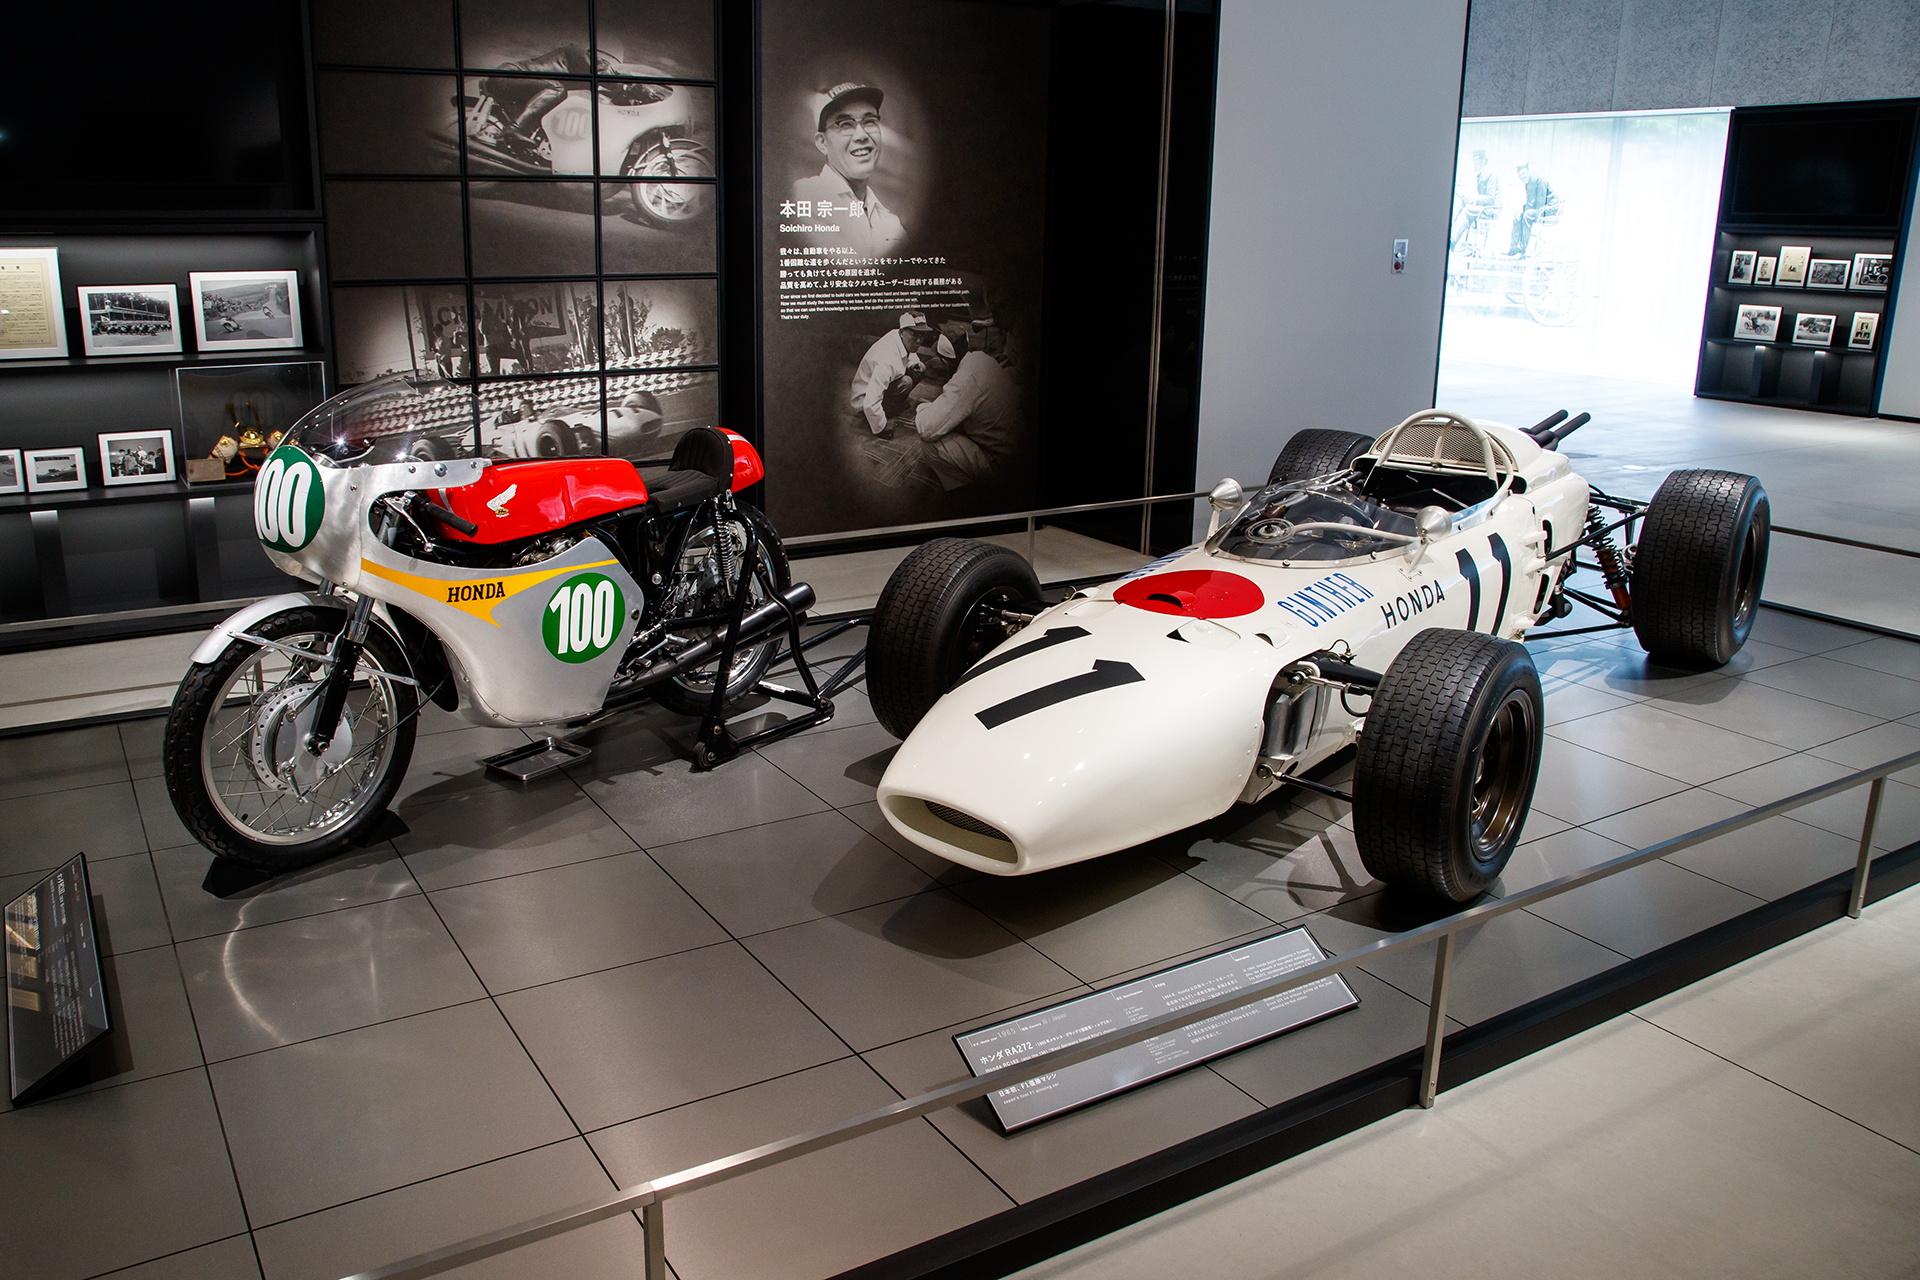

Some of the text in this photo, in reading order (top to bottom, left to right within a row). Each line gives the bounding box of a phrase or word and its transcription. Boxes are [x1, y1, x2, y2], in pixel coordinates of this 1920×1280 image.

[780, 200, 865, 218] 本田 宗一郎
[780, 223, 840, 233] Soichiro Honda
[254, 458, 313, 548] 100
[446, 581, 506, 603] HONDA
[1277, 572, 1375, 628] GINTHER
[1380, 579, 1446, 629] HONDA
[1455, 532, 1511, 636] 11
[549, 579, 615, 655] 100
[947, 625, 1147, 731] 11
[980, 1041, 1034, 1065] ホンダ RA272
[997, 1027, 1016, 1038] 1965
